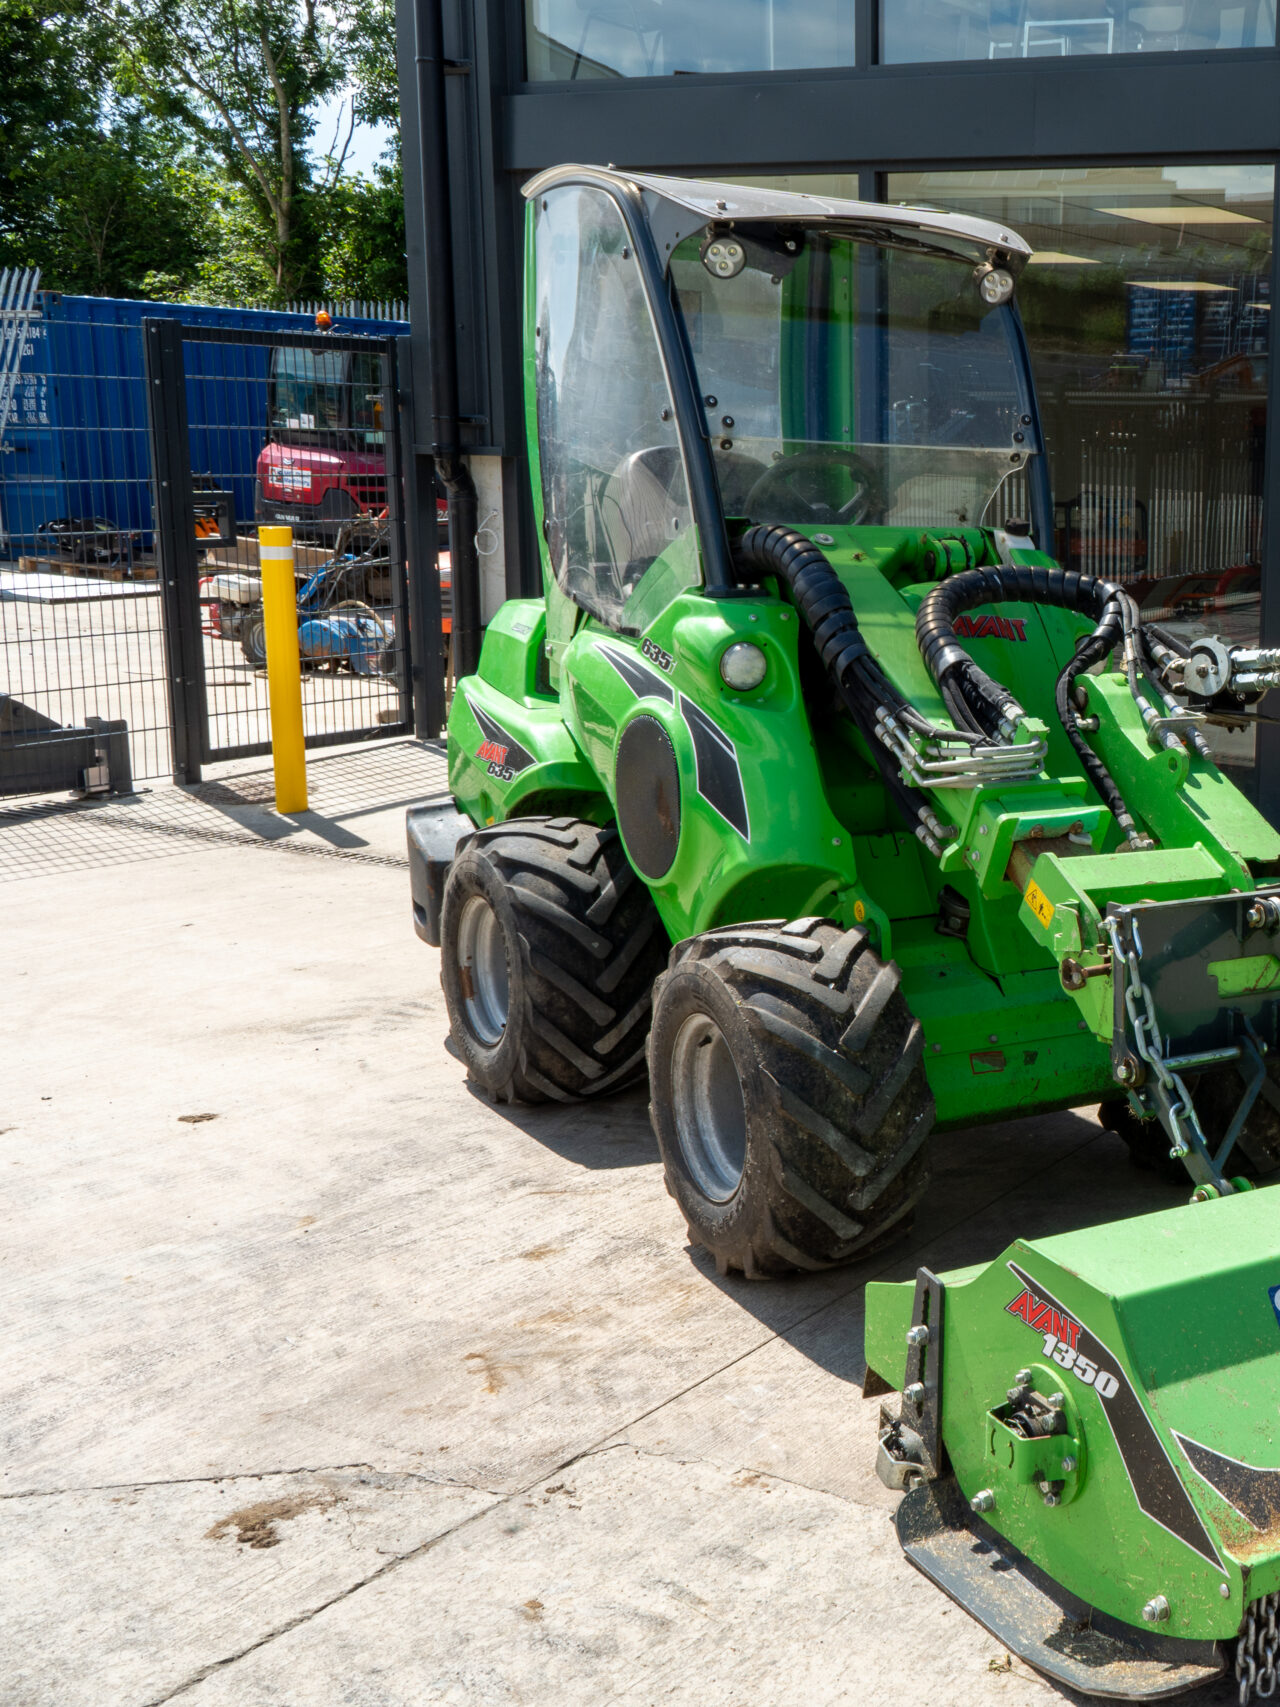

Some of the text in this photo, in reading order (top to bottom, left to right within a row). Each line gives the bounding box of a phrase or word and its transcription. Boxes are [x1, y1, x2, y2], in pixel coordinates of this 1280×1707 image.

[952, 615, 1027, 641] AVANT
[474, 739, 509, 765] AVANT
[1004, 1288, 1082, 1351] AVANT
[1041, 1333, 1120, 1399] 1350
